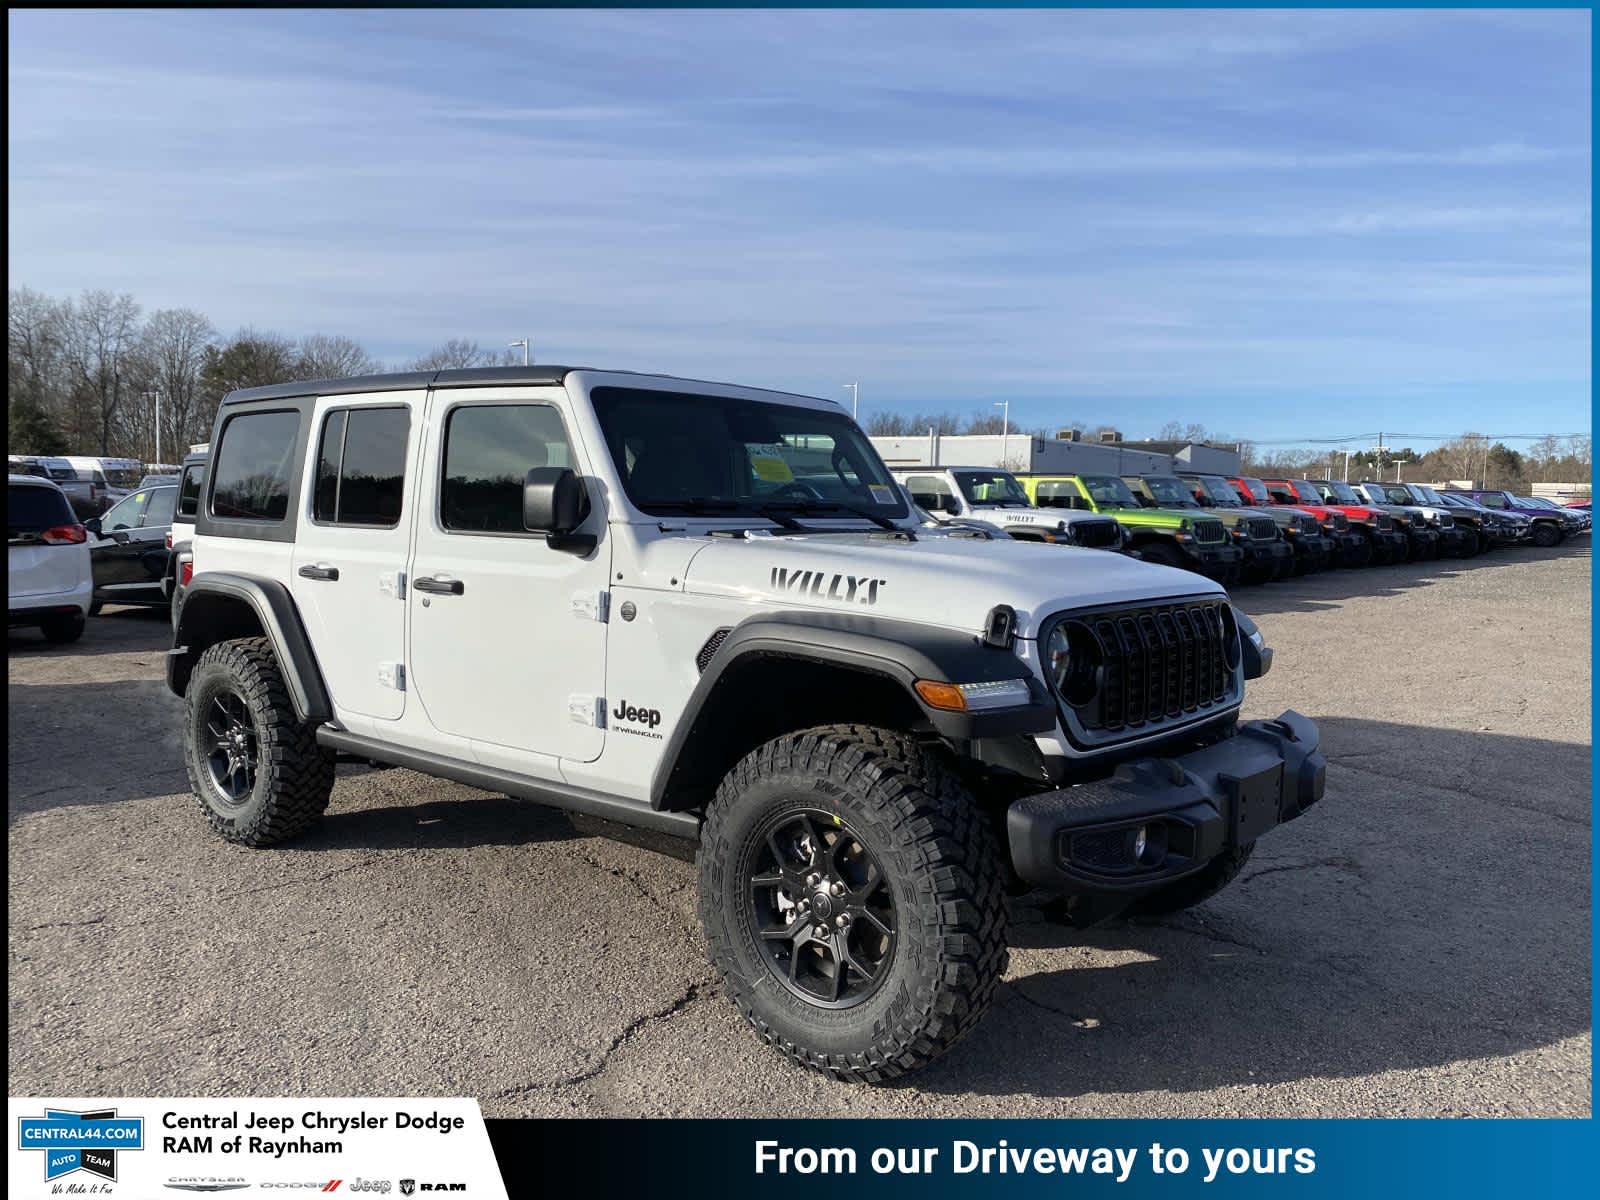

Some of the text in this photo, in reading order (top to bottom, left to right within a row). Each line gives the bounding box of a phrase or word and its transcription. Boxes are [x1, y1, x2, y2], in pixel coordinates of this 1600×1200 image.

[770, 567, 887, 605] WILLYS
[613, 700, 661, 728] Jeep
[616, 726, 663, 740] WRANGLER
